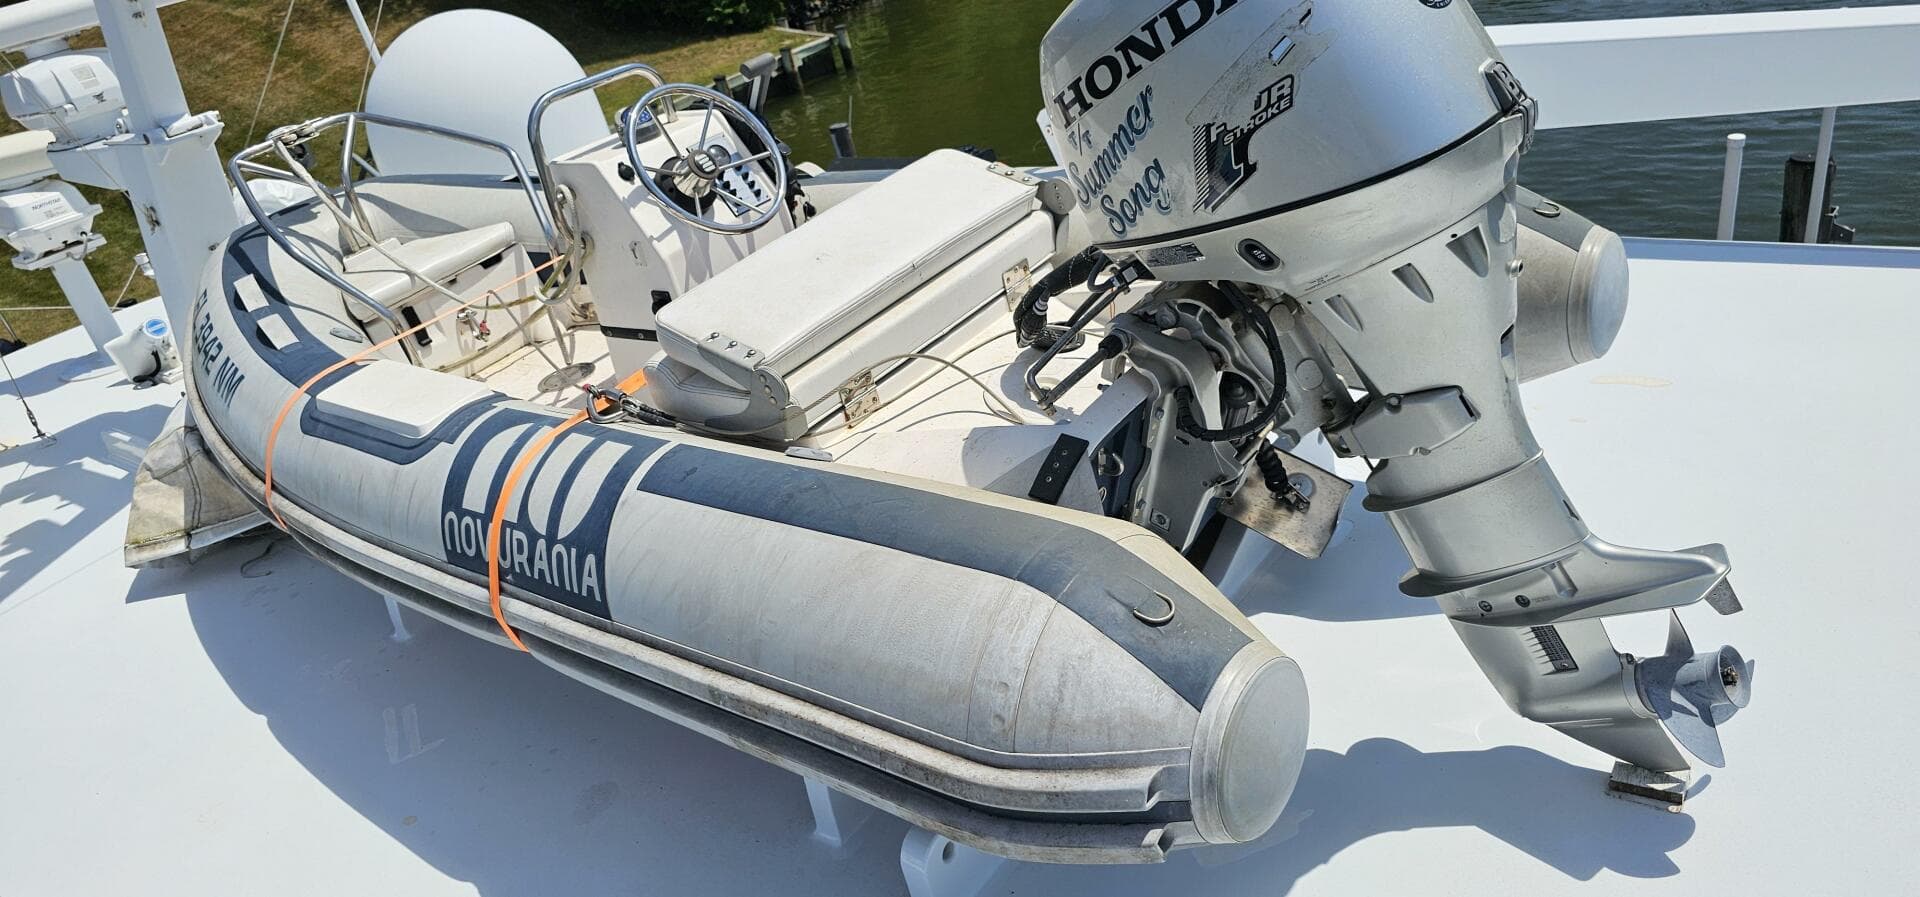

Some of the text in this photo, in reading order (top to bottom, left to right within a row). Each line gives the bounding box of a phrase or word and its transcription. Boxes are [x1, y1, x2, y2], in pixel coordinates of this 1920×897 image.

[1054, 0, 1243, 129] HOND
[1069, 84, 1154, 213] Summer
[1223, 96, 1292, 146] STROKE
[1100, 157, 1172, 239] Song
[195, 312, 224, 376] 3942
[213, 356, 246, 408] NM
[444, 511, 602, 602] NOVURANIA
